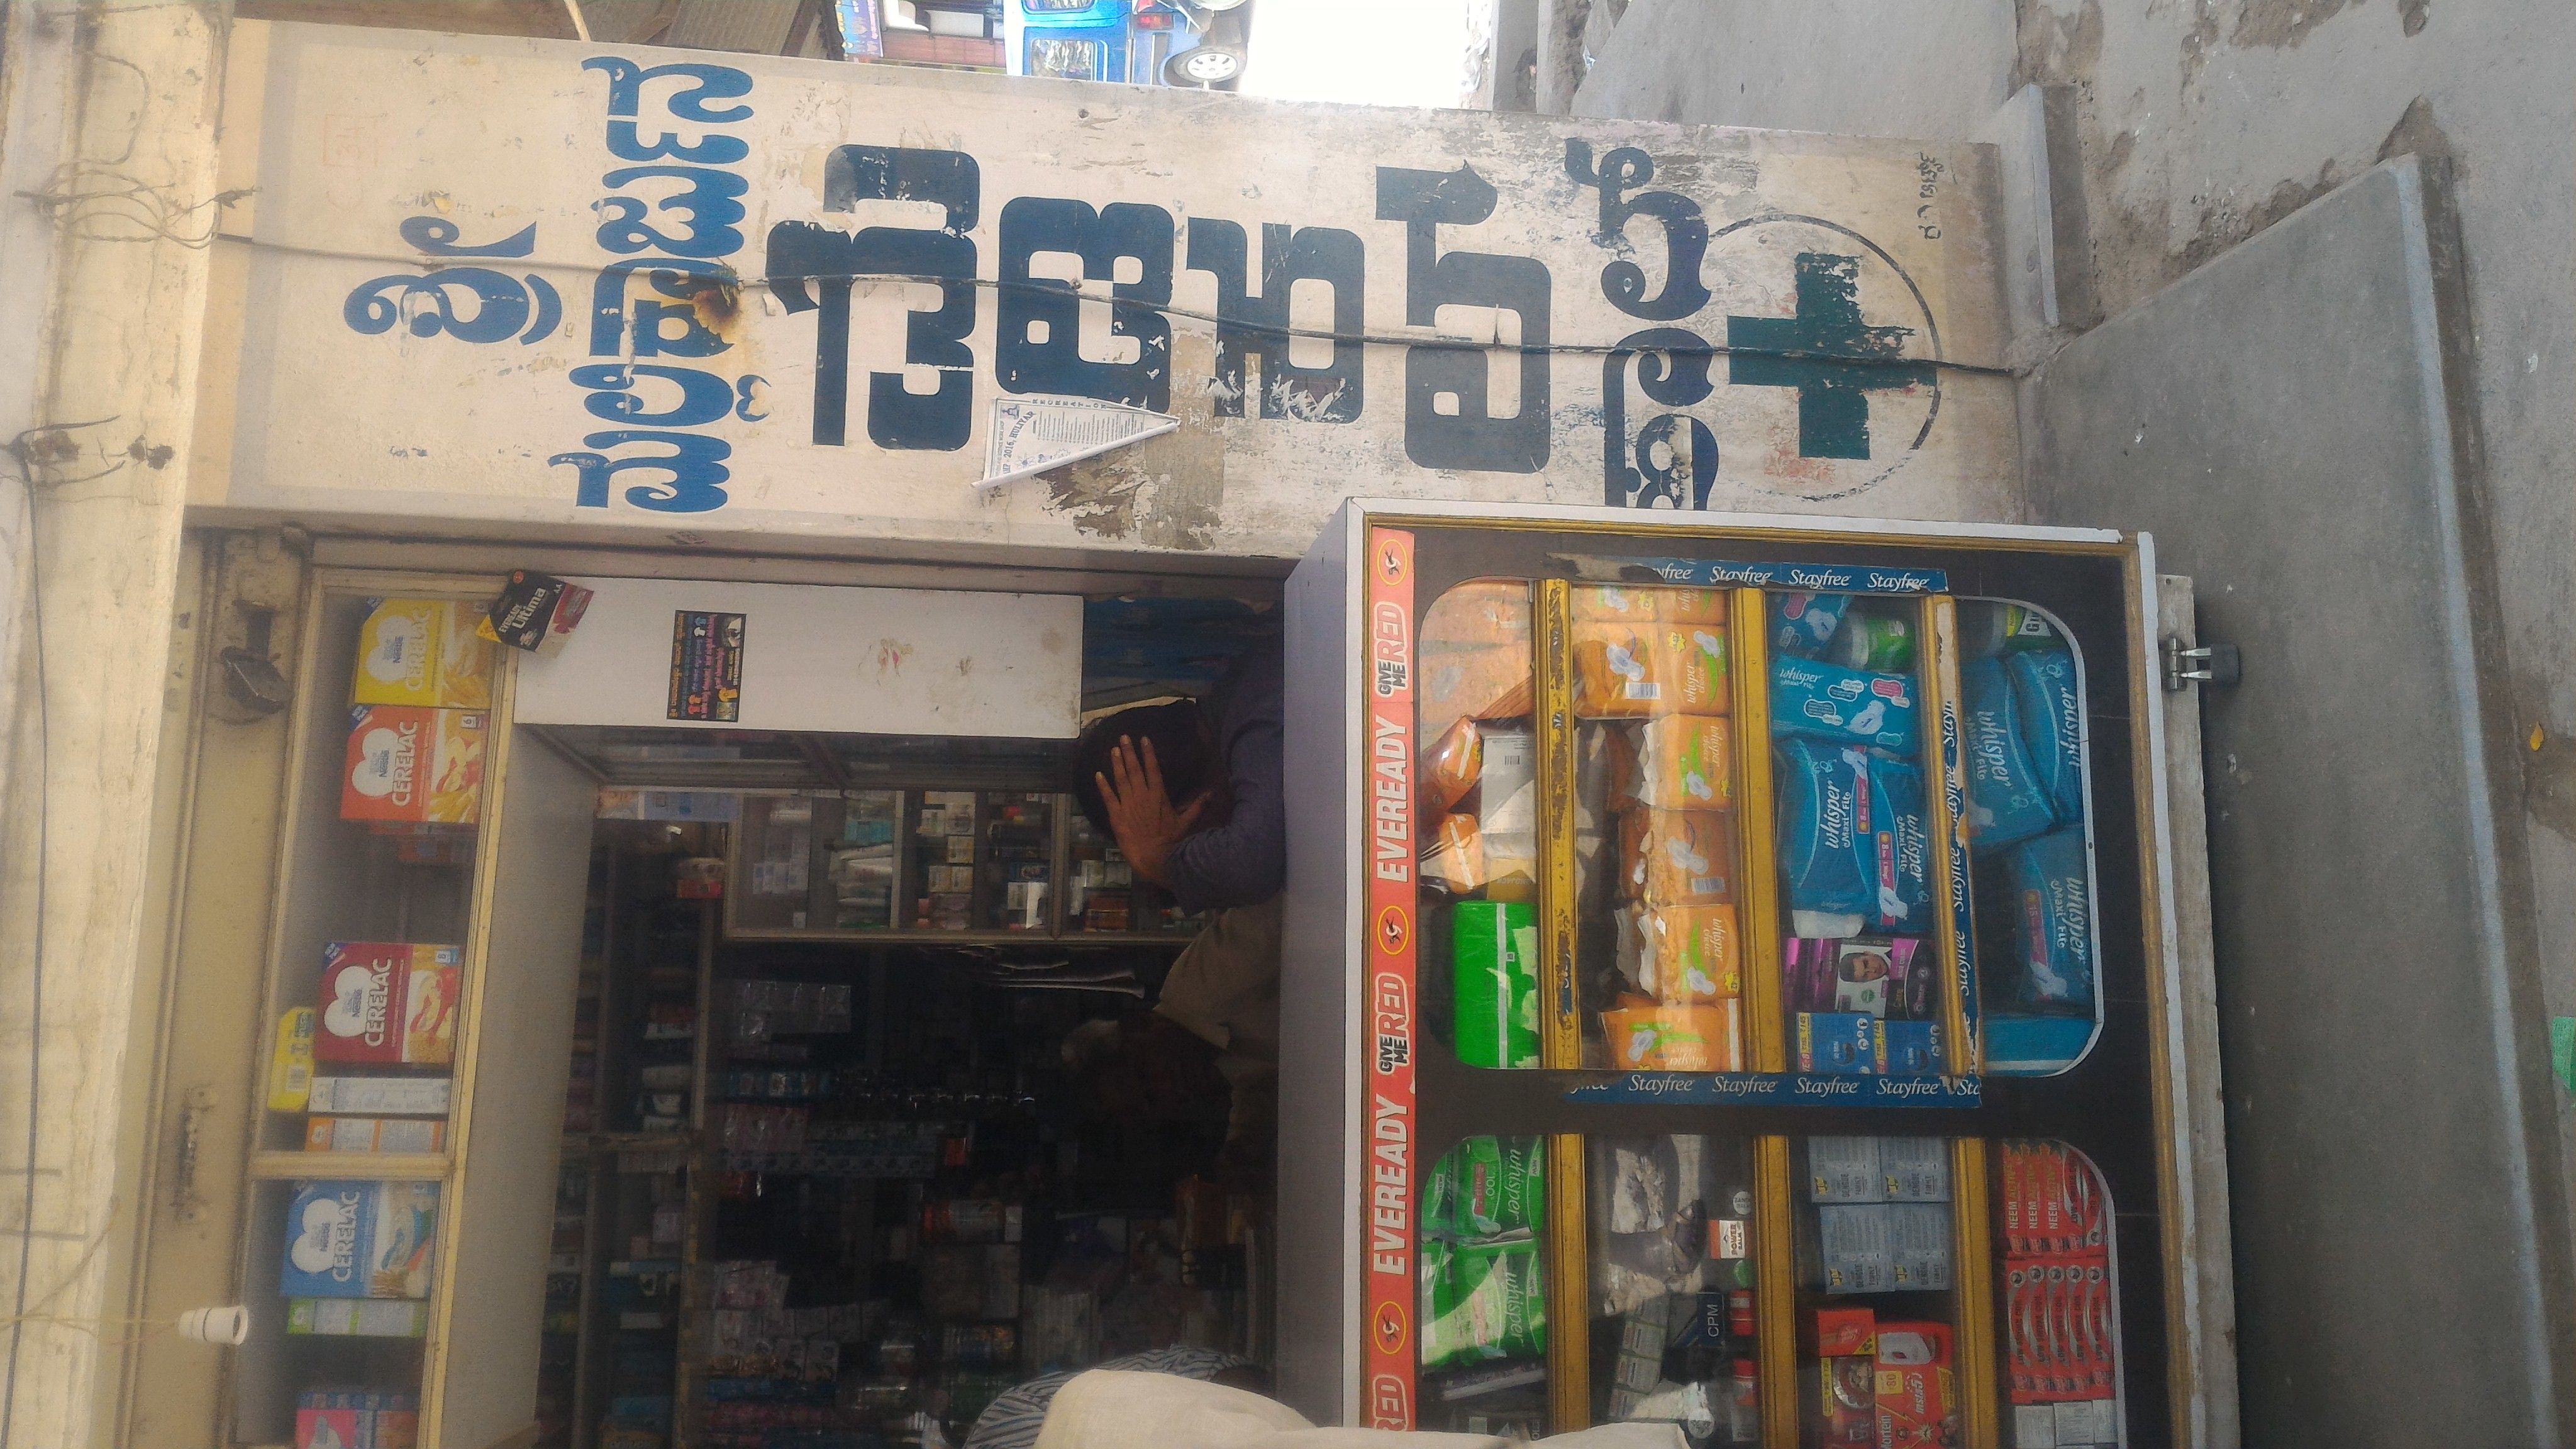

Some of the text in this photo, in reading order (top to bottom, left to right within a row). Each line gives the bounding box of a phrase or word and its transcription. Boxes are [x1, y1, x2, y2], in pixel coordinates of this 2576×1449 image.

[343, 216, 562, 344] ಶ್ರೀ
[547, 56, 772, 513] ಮಲ್ಲಿಕಾರ್ಜುನ
[1009, 411, 1036, 438] HULIYAR
[1788, 569, 1853, 589] Stayfree
[1867, 572, 1930, 591] Stayfree
[512, 587, 547, 629] Ultima
[404, 608, 431, 692] CERELAC
[1375, 606, 1407, 687] ME RED
[1377, 661, 1393, 694] GIVE
[1684, 662, 1699, 704] whisper
[1780, 667, 1823, 685] whisper
[391, 721, 418, 806] CERELAC
[1977, 711, 2012, 786] whisper
[1375, 713, 1408, 882] EVEREADY
[1819, 780, 1846, 848] whisper
[1903, 814, 1925, 884] whisper
[1710, 918, 1726, 958] whisper
[2062, 877, 2088, 960] whisper
[365, 957, 392, 1047] CERELAC
[1376, 975, 1408, 1065] ME RED
[1378, 1036, 1394, 1072] GIVE
[1628, 1074, 1695, 1096] Stayfree
[1712, 1076, 1778, 1097] Stayfree
[1794, 1077, 1860, 1098] Stayfree
[1875, 1078, 1940, 1099] Stayfree
[1374, 1092, 1408, 1275] EVEREADY
[1502, 1149, 1526, 1220] whisper
[2008, 1201, 2019, 1229] NEEM
[2028, 1201, 2038, 1229] NEEM
[2048, 1202, 2058, 1230] NEEM
[332, 1191, 360, 1283] CERELAC
[1501, 1272, 1526, 1343] whisper
[1706, 1303, 1719, 1337] CPM
